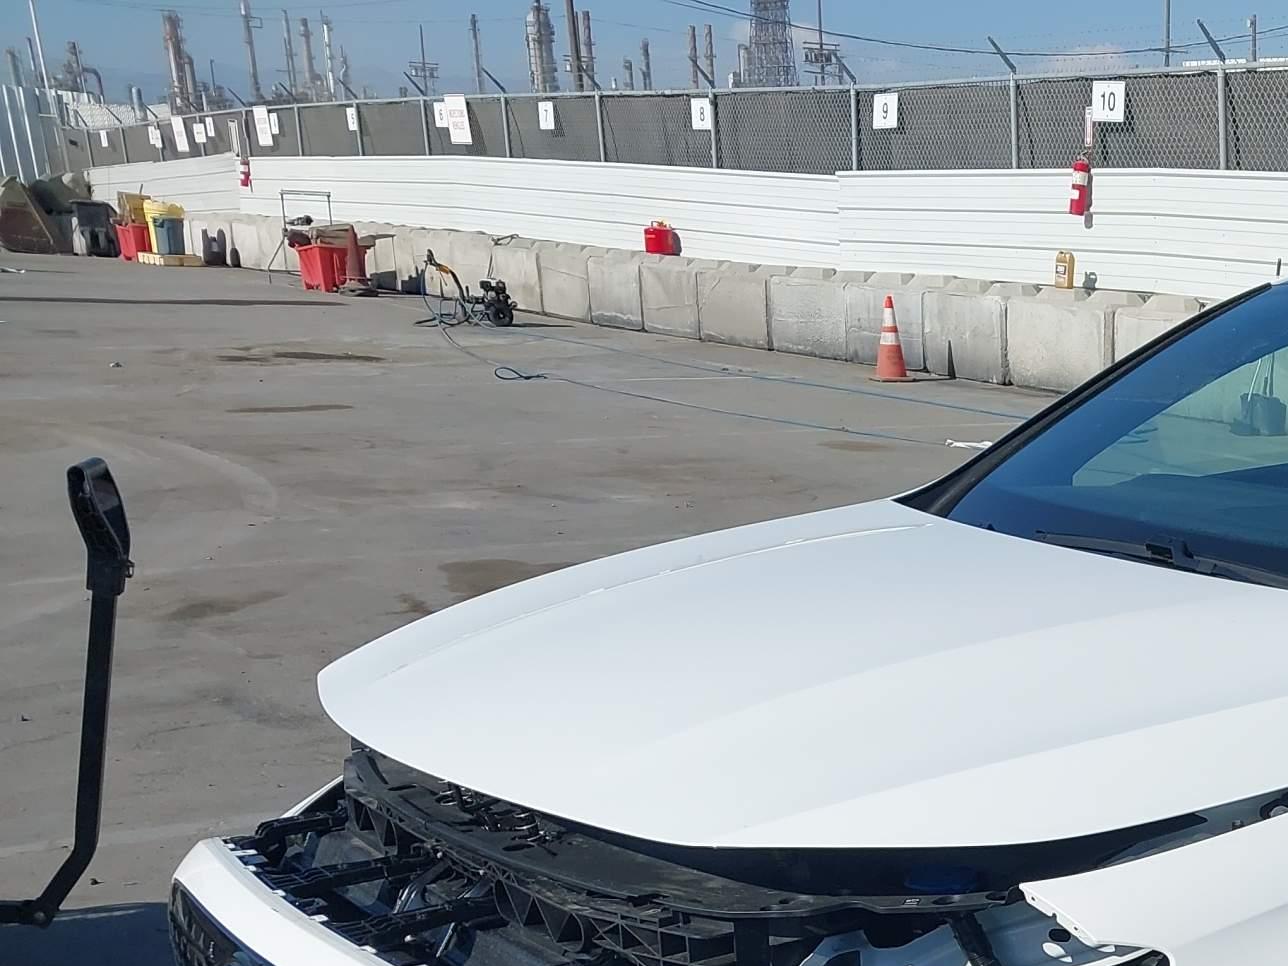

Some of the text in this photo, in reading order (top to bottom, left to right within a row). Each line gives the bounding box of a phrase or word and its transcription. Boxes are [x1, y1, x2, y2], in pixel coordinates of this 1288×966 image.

[1101, 91, 1116, 112] 10
[543, 109, 548, 122] 7
[699, 107, 705, 122] 8
[882, 102, 889, 120] 9
